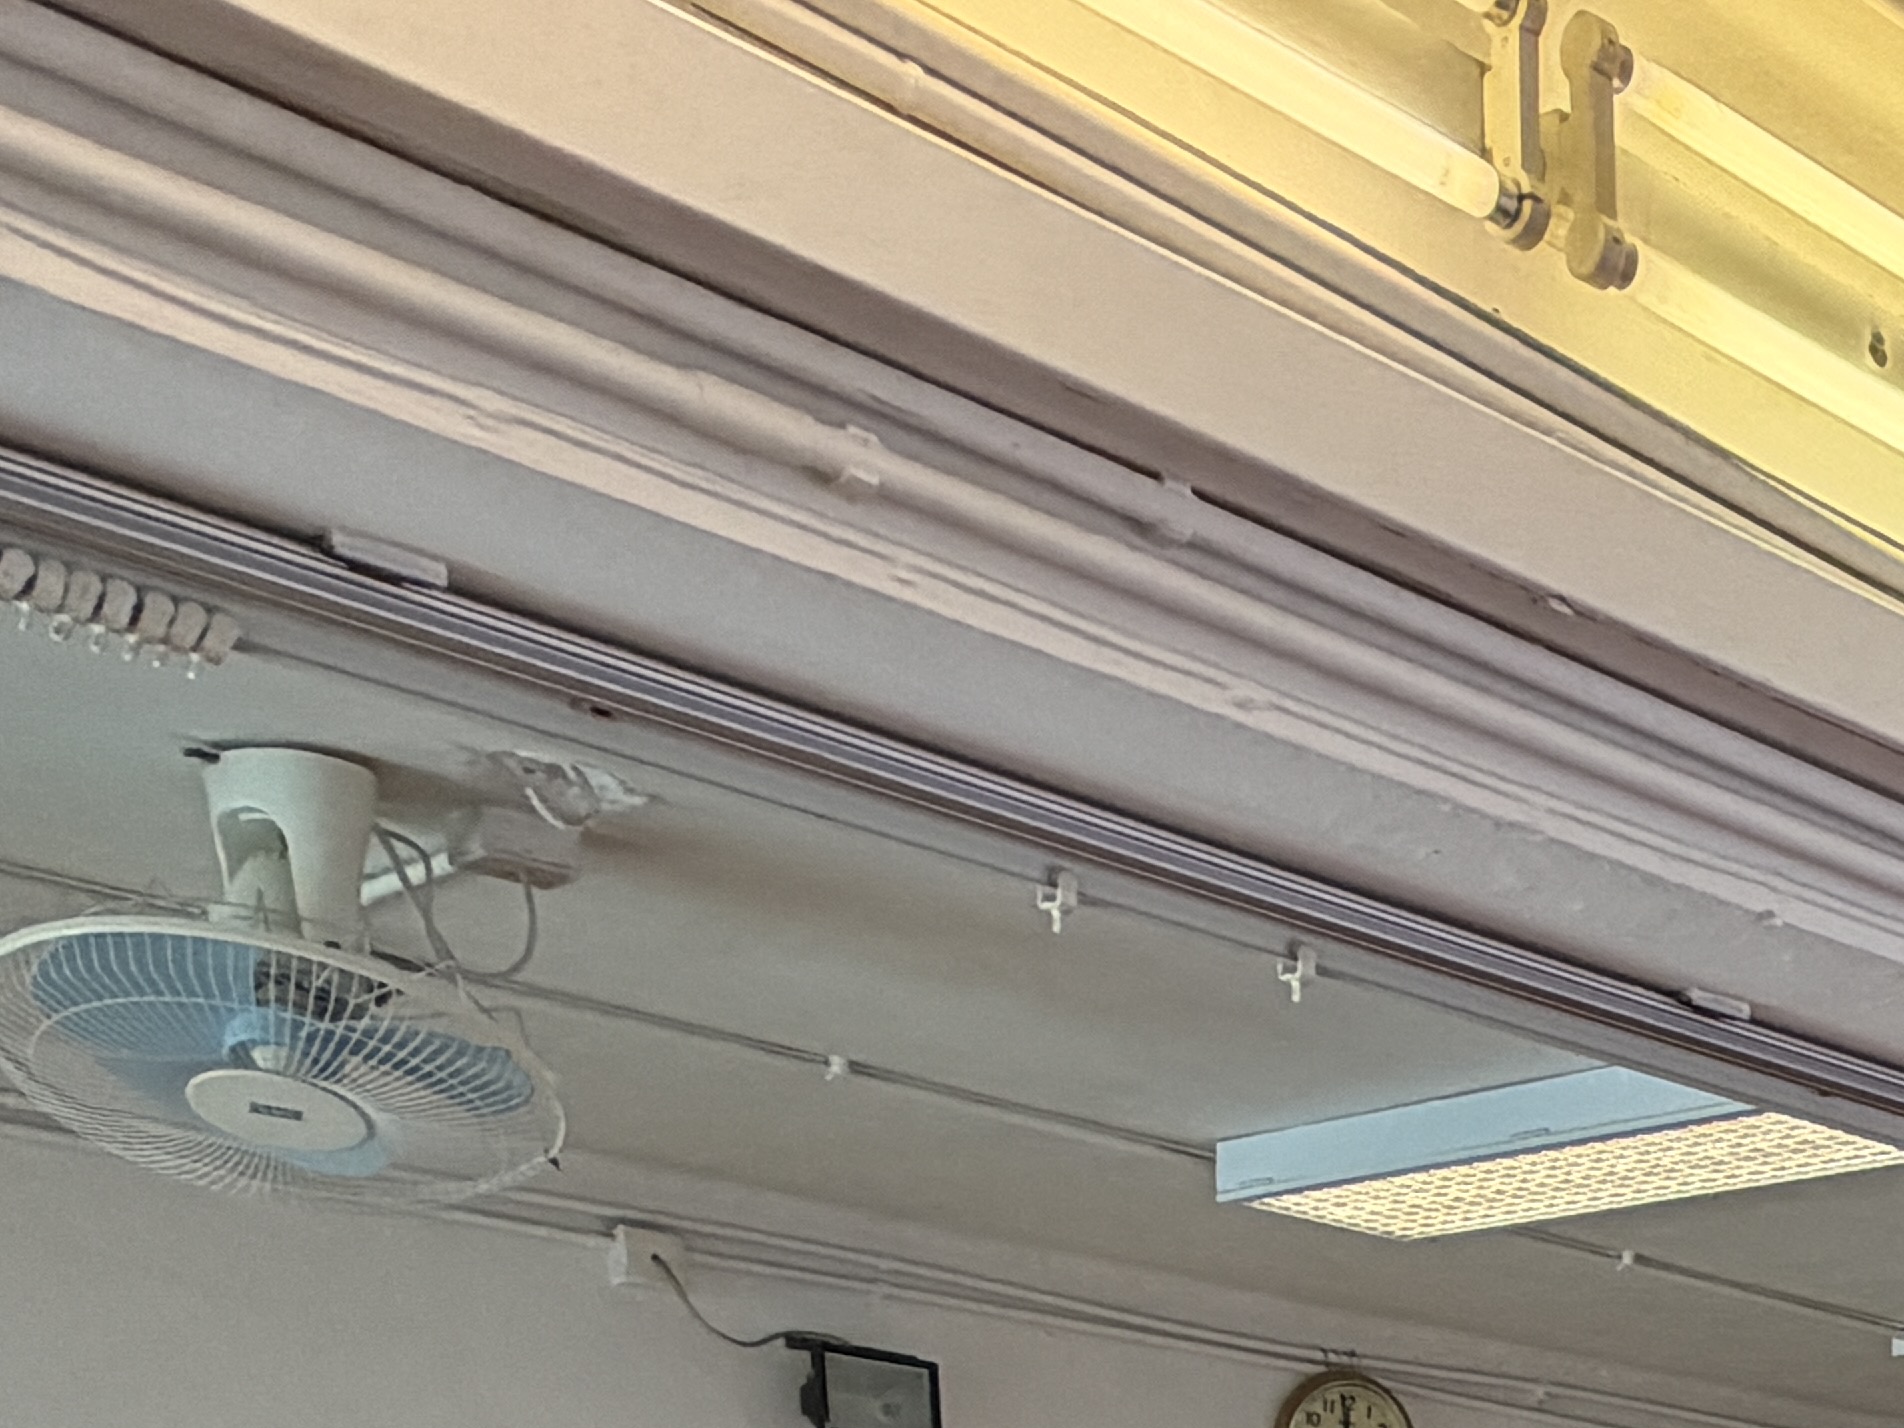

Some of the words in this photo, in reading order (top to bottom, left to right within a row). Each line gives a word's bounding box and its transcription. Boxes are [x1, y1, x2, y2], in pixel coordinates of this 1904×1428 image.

[1323, 1397, 1336, 1414] 11
[1366, 1405, 1372, 1420] 1
[1305, 1412, 1321, 1427] 10
